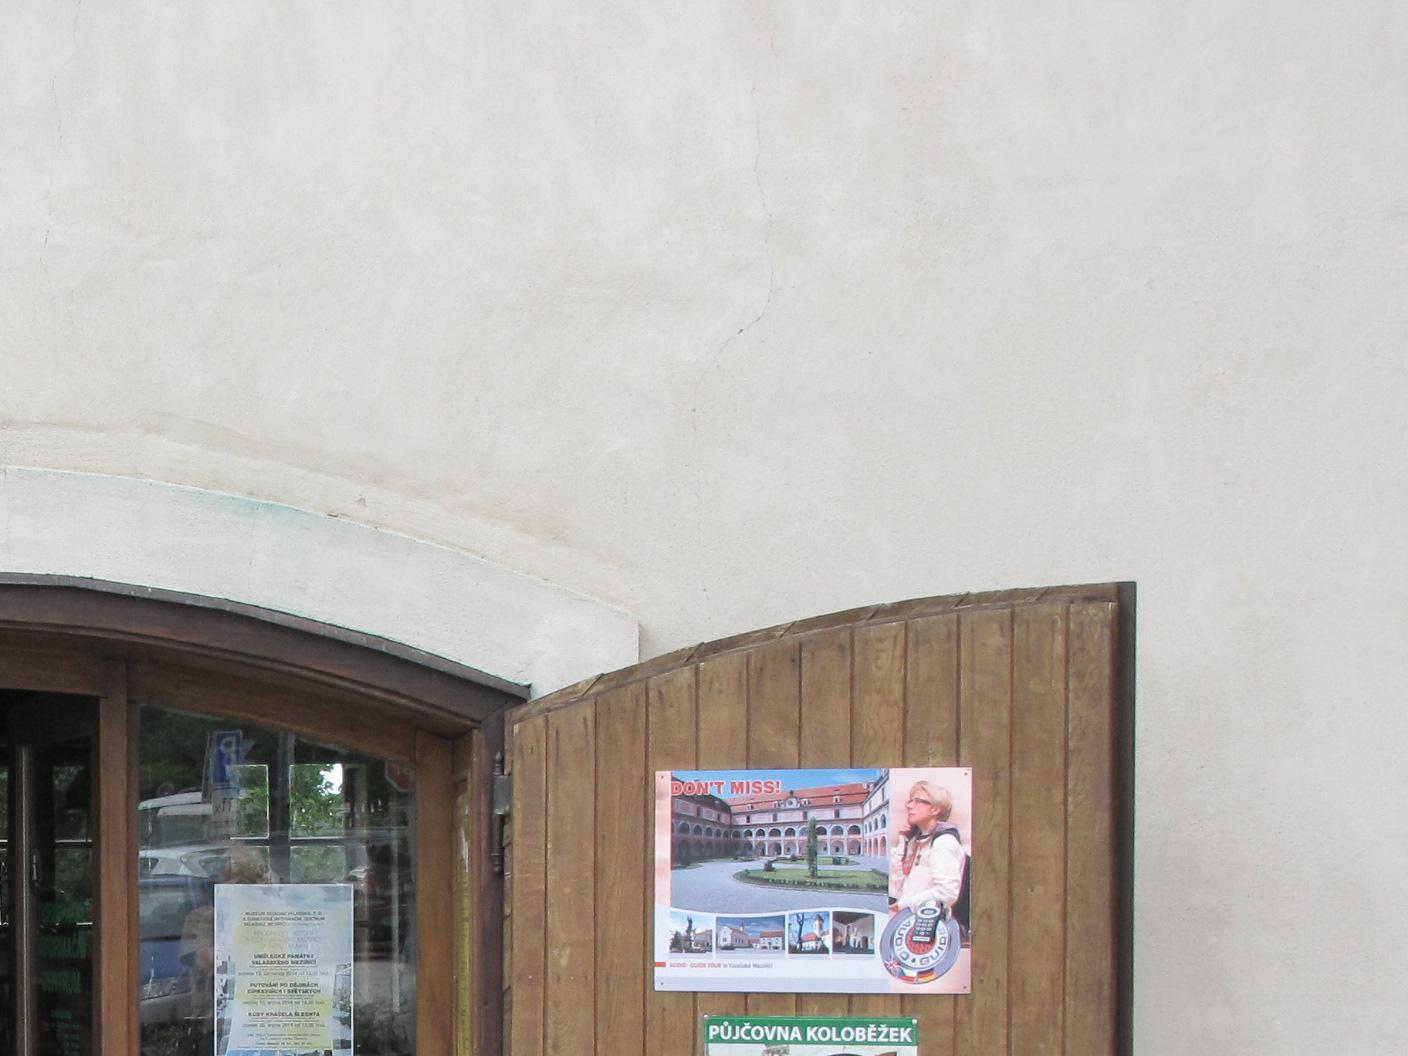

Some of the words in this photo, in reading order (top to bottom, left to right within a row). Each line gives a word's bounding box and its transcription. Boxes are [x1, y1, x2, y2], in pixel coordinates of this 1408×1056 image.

[671, 780, 724, 796] DON'T
[730, 778, 782, 794] MISS!
[708, 1020, 802, 1042] PŮJČOVNA
[807, 1023, 913, 1043] KOLOBĚŽEK
